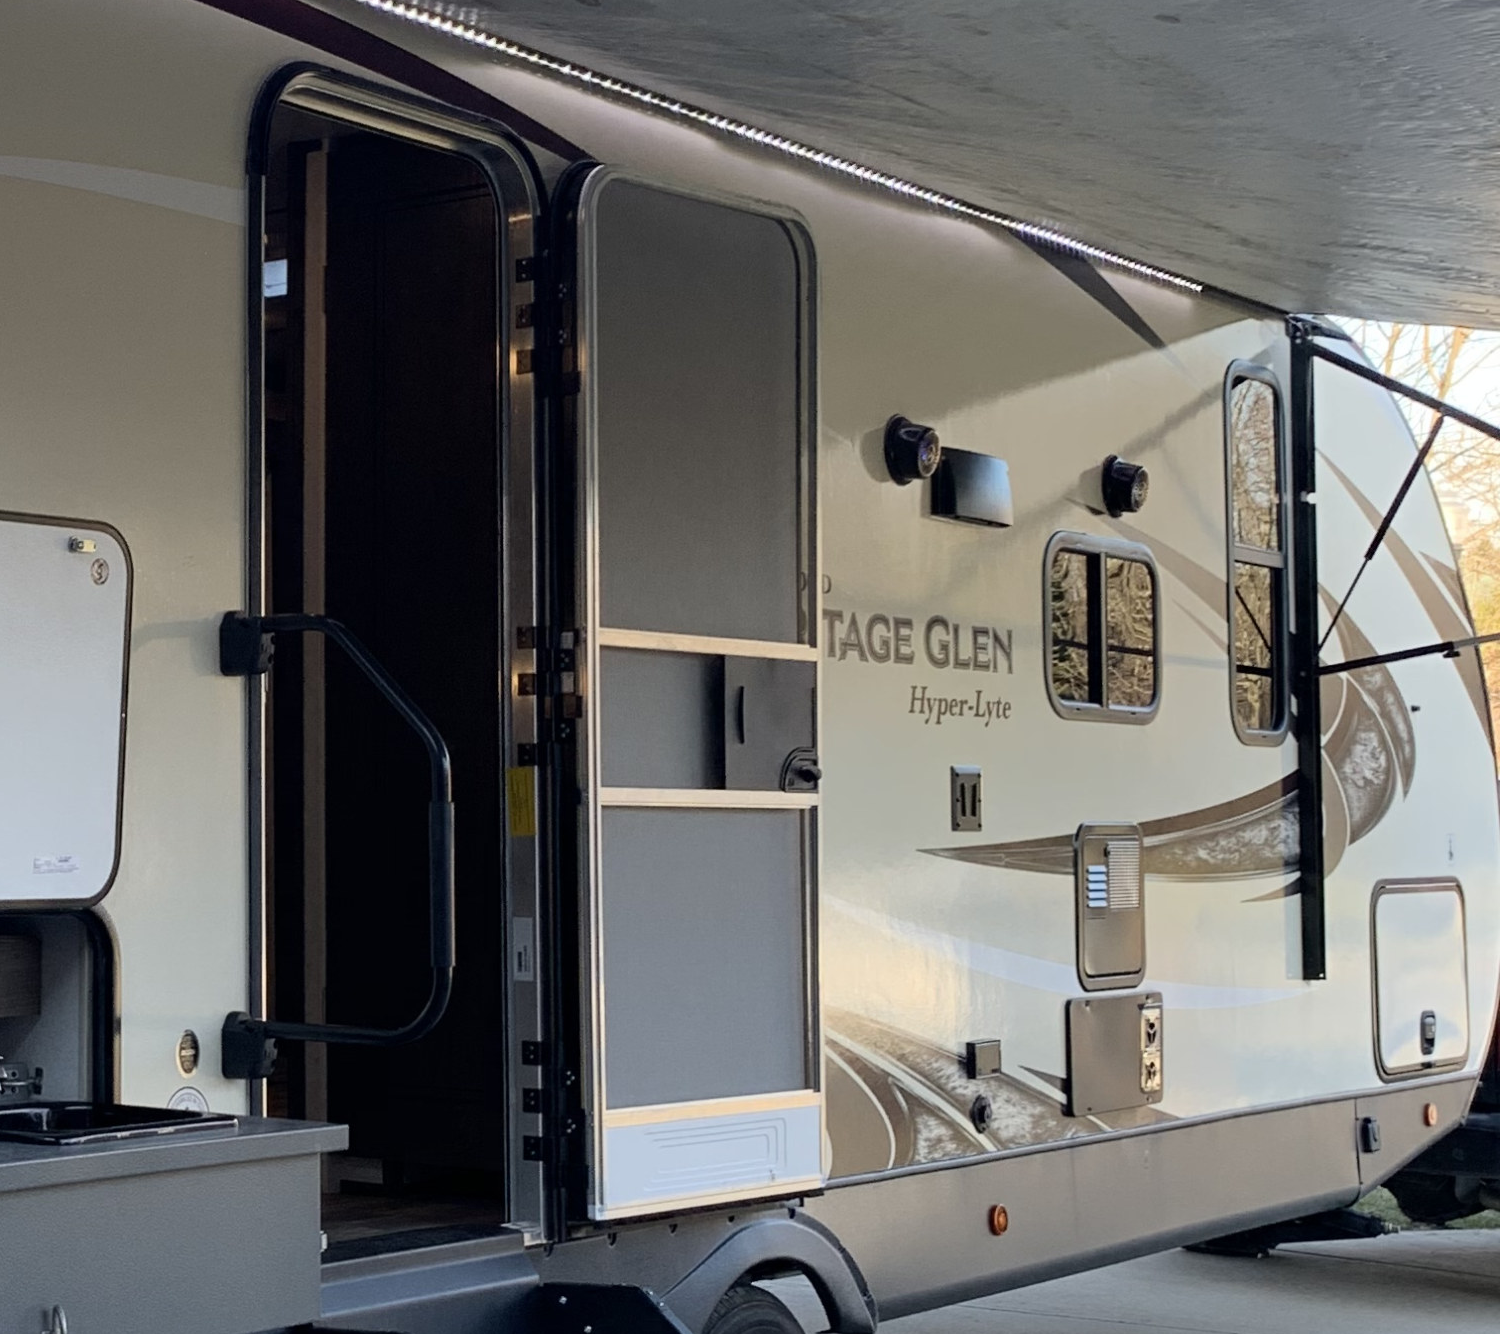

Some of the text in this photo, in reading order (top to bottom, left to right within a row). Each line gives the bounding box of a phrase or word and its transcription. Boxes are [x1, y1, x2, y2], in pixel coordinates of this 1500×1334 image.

[822, 609, 1014, 675] TAGE GLEN
[908, 685, 1013, 728] Hyper-Lyte
